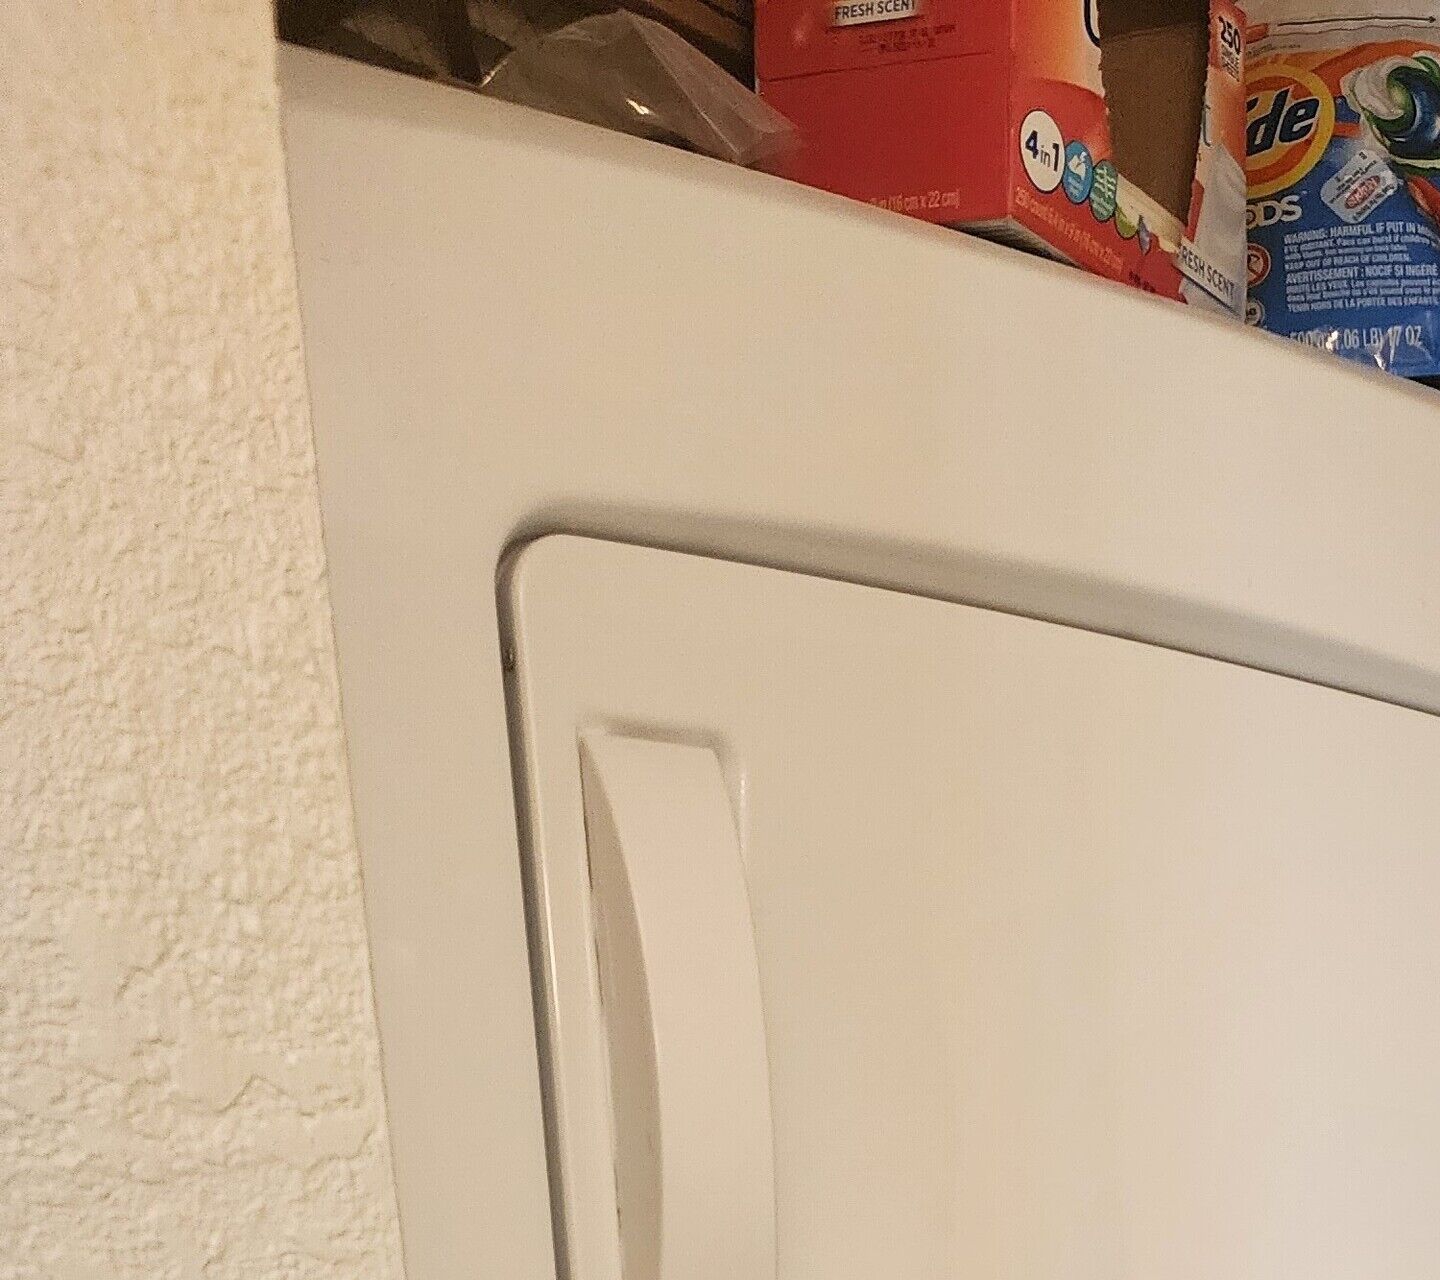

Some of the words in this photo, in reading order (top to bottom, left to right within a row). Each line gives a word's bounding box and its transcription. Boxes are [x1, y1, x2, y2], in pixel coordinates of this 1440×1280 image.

[834, 1, 875, 20] FRESH
[877, 0, 916, 13] SCENT
[1218, 15, 1241, 55] 250
[1248, 196, 1302, 231] ODS
[1284, 227, 1328, 244] WARNING:
[1330, 223, 1374, 238] HARMFUL
[1376, 221, 1384, 233] IF
[1386, 221, 1404, 233] PUT
[1406, 222, 1416, 233] IN
[1182, 246, 1205, 278] RESH
[1207, 264, 1235, 299] SCENT
